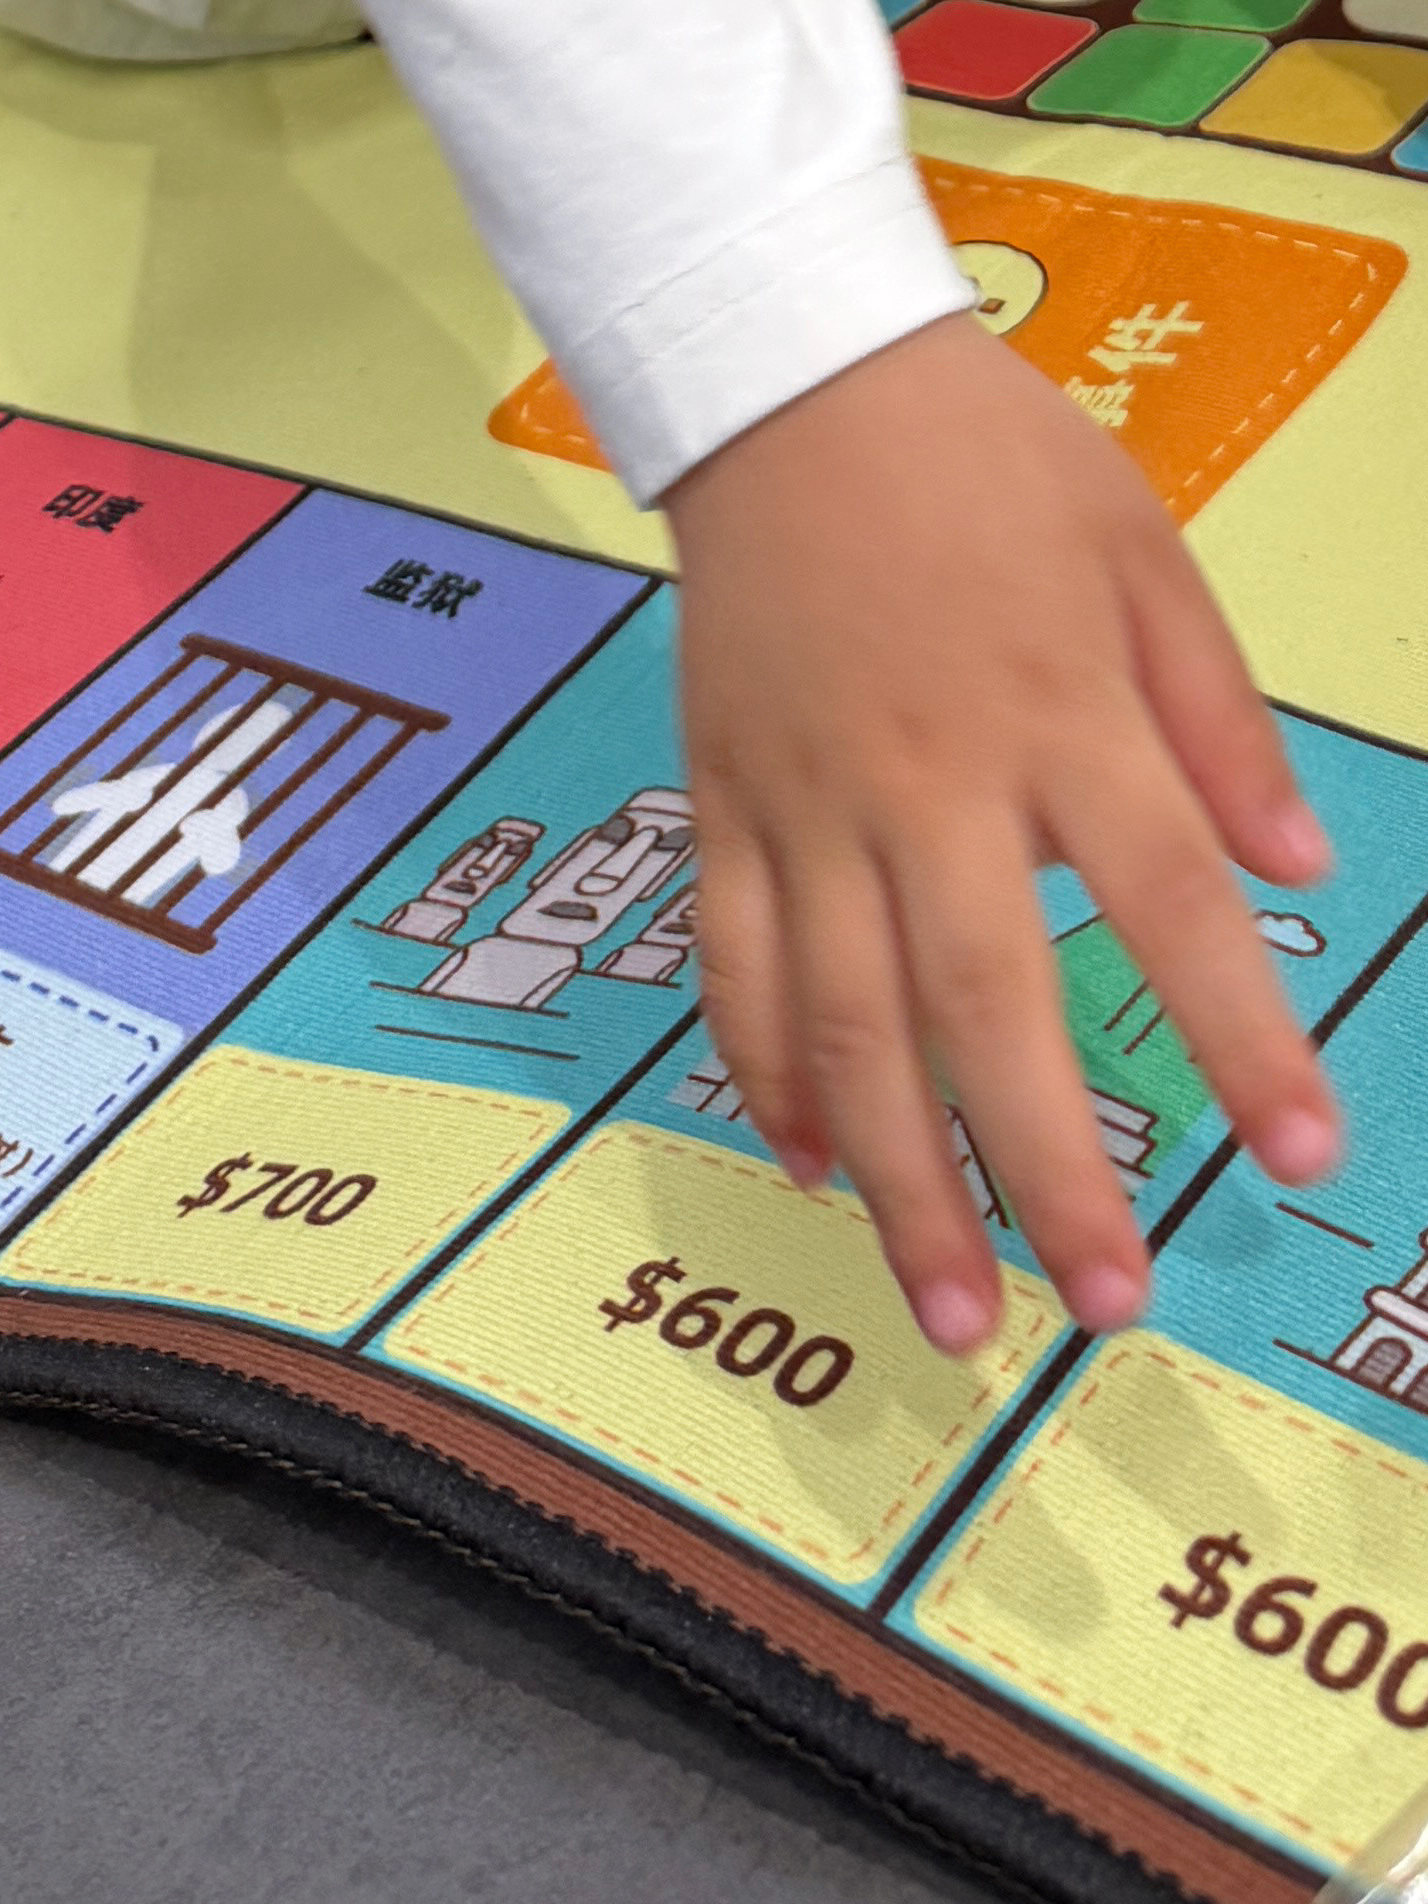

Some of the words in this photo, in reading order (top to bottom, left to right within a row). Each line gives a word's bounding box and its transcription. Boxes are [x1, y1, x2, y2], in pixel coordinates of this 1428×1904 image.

[41, 484, 145, 534] 印度
[361, 559, 484, 619] 监狱
[176, 1152, 378, 1226] $700
[597, 1256, 856, 1408] $600
